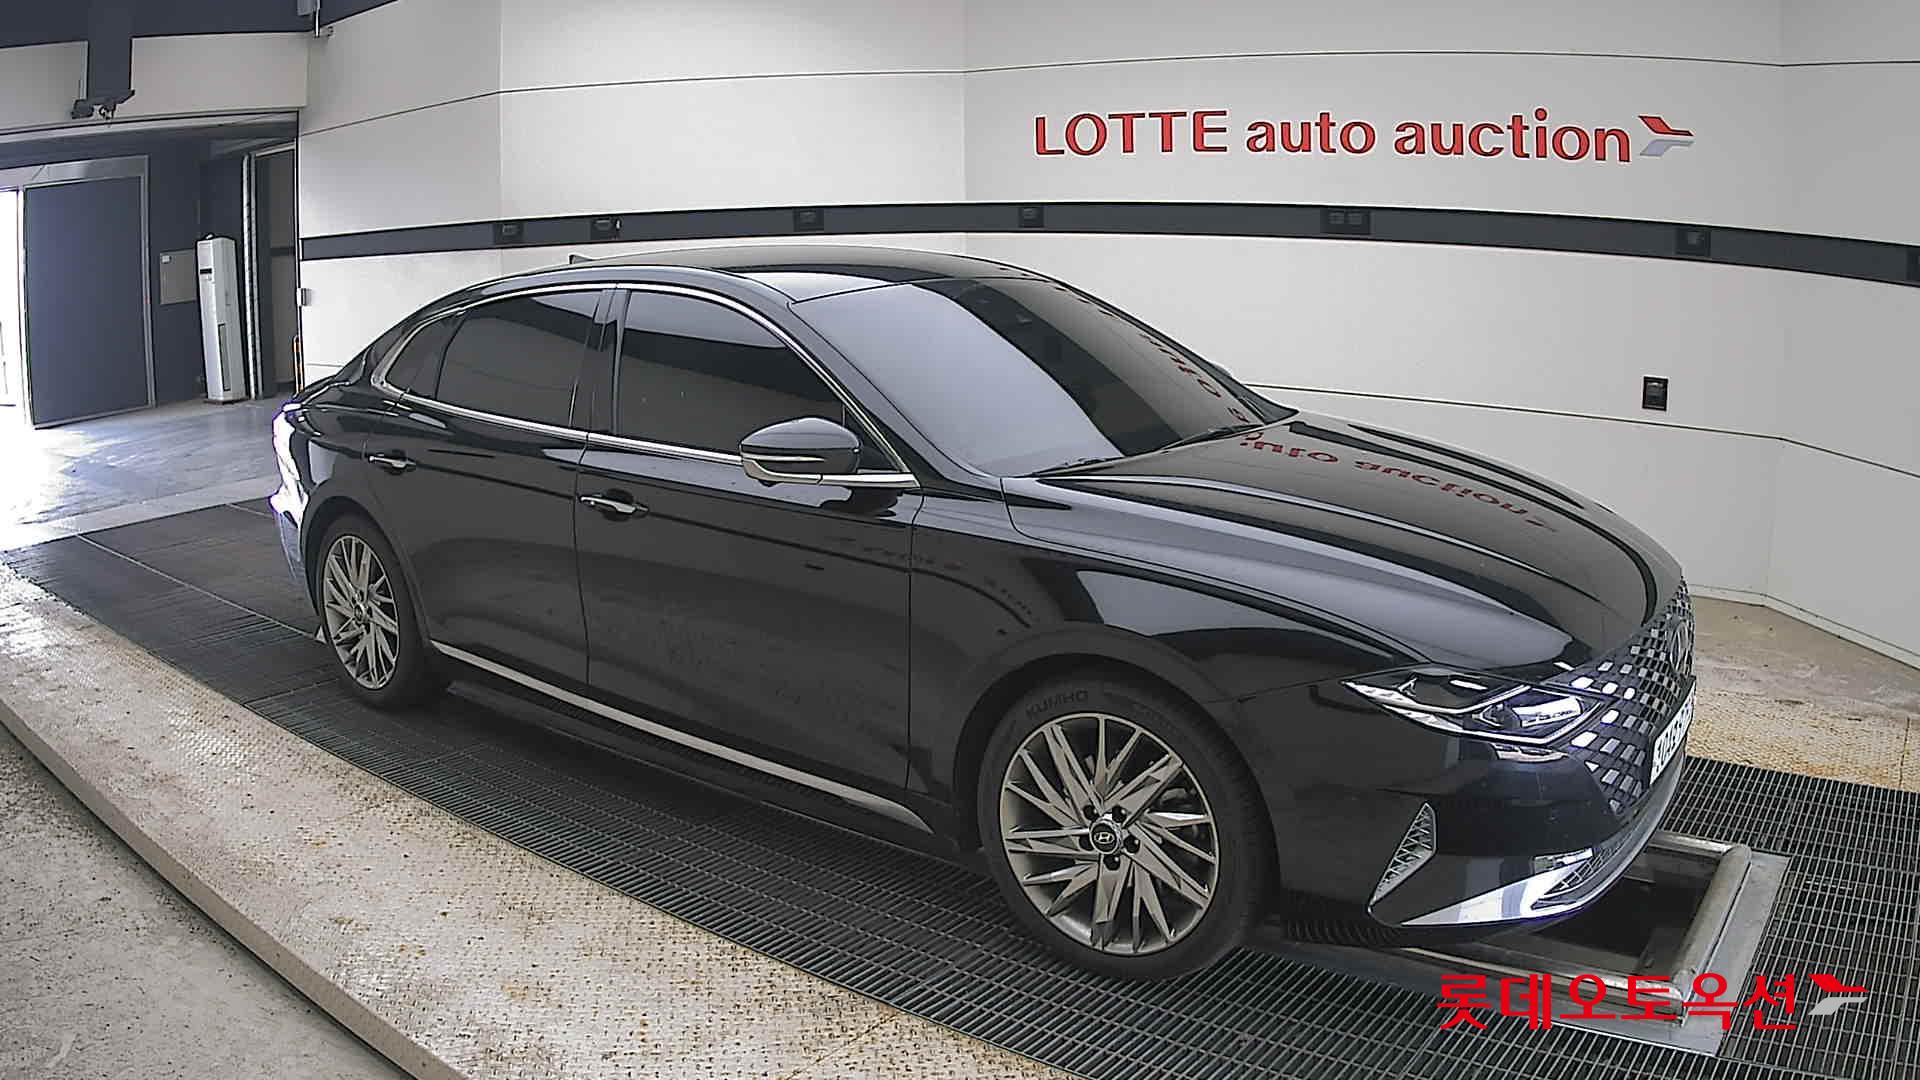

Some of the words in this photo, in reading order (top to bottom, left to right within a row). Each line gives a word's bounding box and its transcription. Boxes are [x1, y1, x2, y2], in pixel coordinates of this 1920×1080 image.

[1035, 110, 1228, 156] LOTTE
[1246, 111, 1376, 155] auto
[1394, 108, 1631, 162] auction
